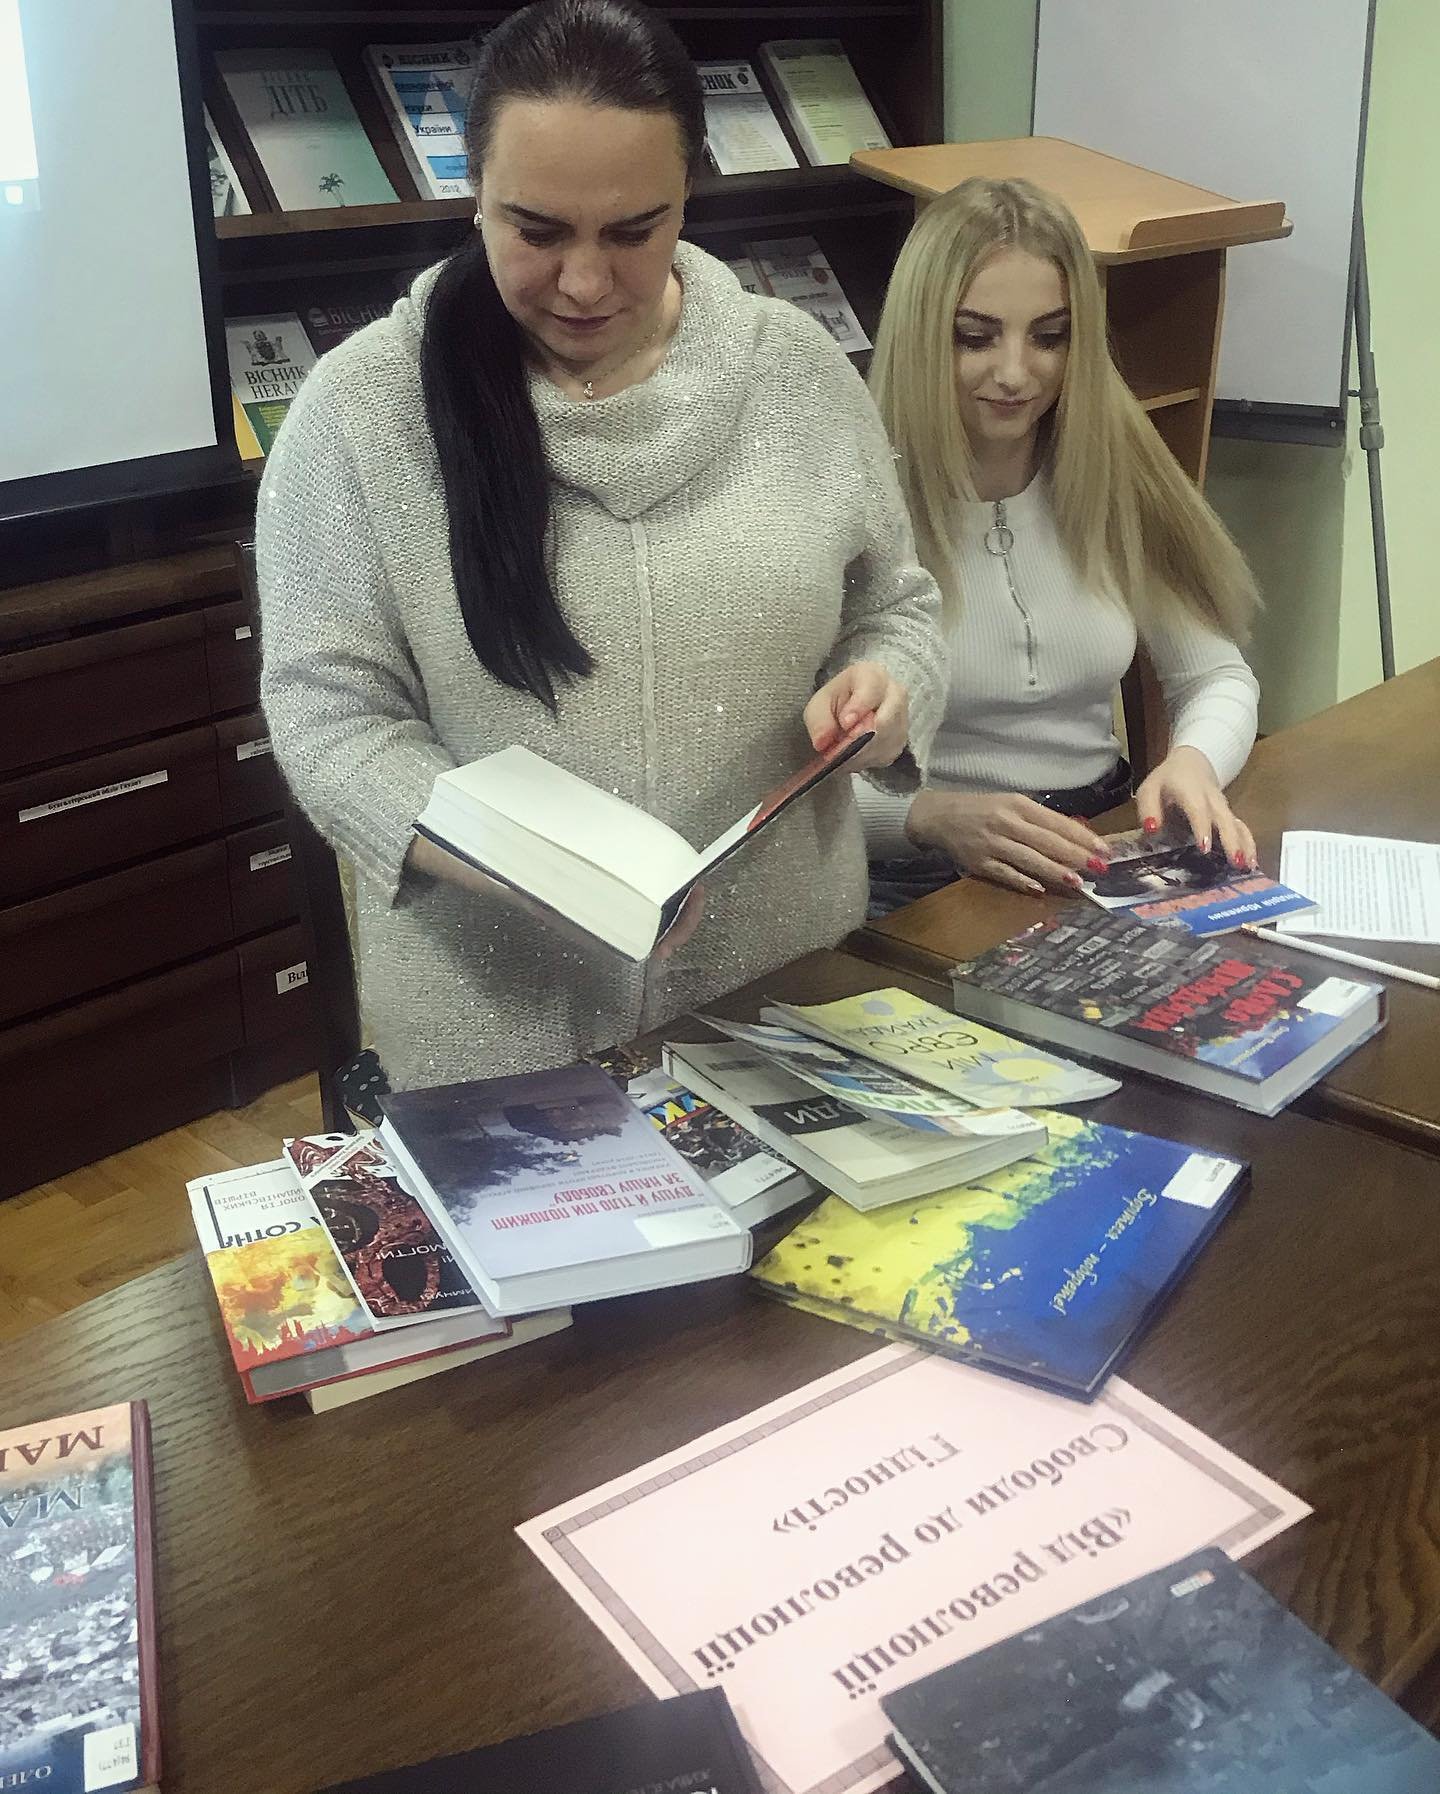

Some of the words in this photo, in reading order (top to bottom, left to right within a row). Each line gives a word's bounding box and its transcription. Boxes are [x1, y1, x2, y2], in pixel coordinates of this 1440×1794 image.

[412, 125, 452, 136] України
[440, 184, 461, 194] 2012
[244, 365, 307, 385] ВІСНИК
[618, 1176, 662, 1193] НАШУ
[661, 1172, 684, 1185] ЗА
[570, 1201, 599, 1216] МИ
[599, 1196, 635, 1211] ТІЛО
[490, 1206, 571, 1231] ПОЛОЖИМ
[964, 1423, 1129, 1516] Свободи
[772, 1433, 961, 1534] Гідності»
[914, 1505, 962, 1544] до
[1040, 1508, 1131, 1563] «Від
[691, 1533, 912, 1678] революції
[831, 1550, 1046, 1700] революції
